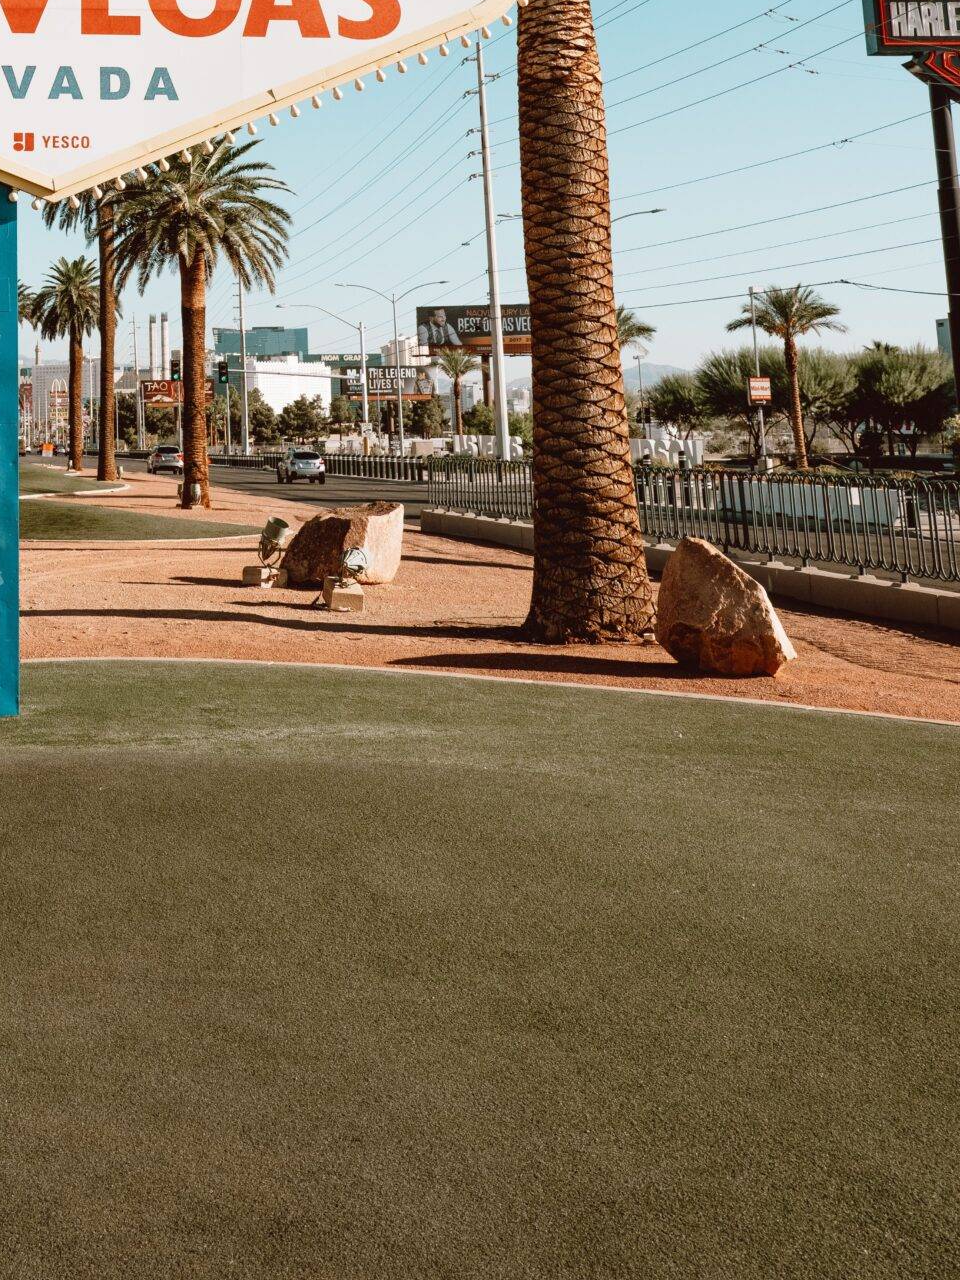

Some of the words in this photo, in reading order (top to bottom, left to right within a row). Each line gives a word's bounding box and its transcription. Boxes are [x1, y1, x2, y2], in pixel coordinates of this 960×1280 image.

[42, 135, 90, 149] YESCO
[457, 317, 482, 332] BEST
[144, 381, 168, 392] TAO
